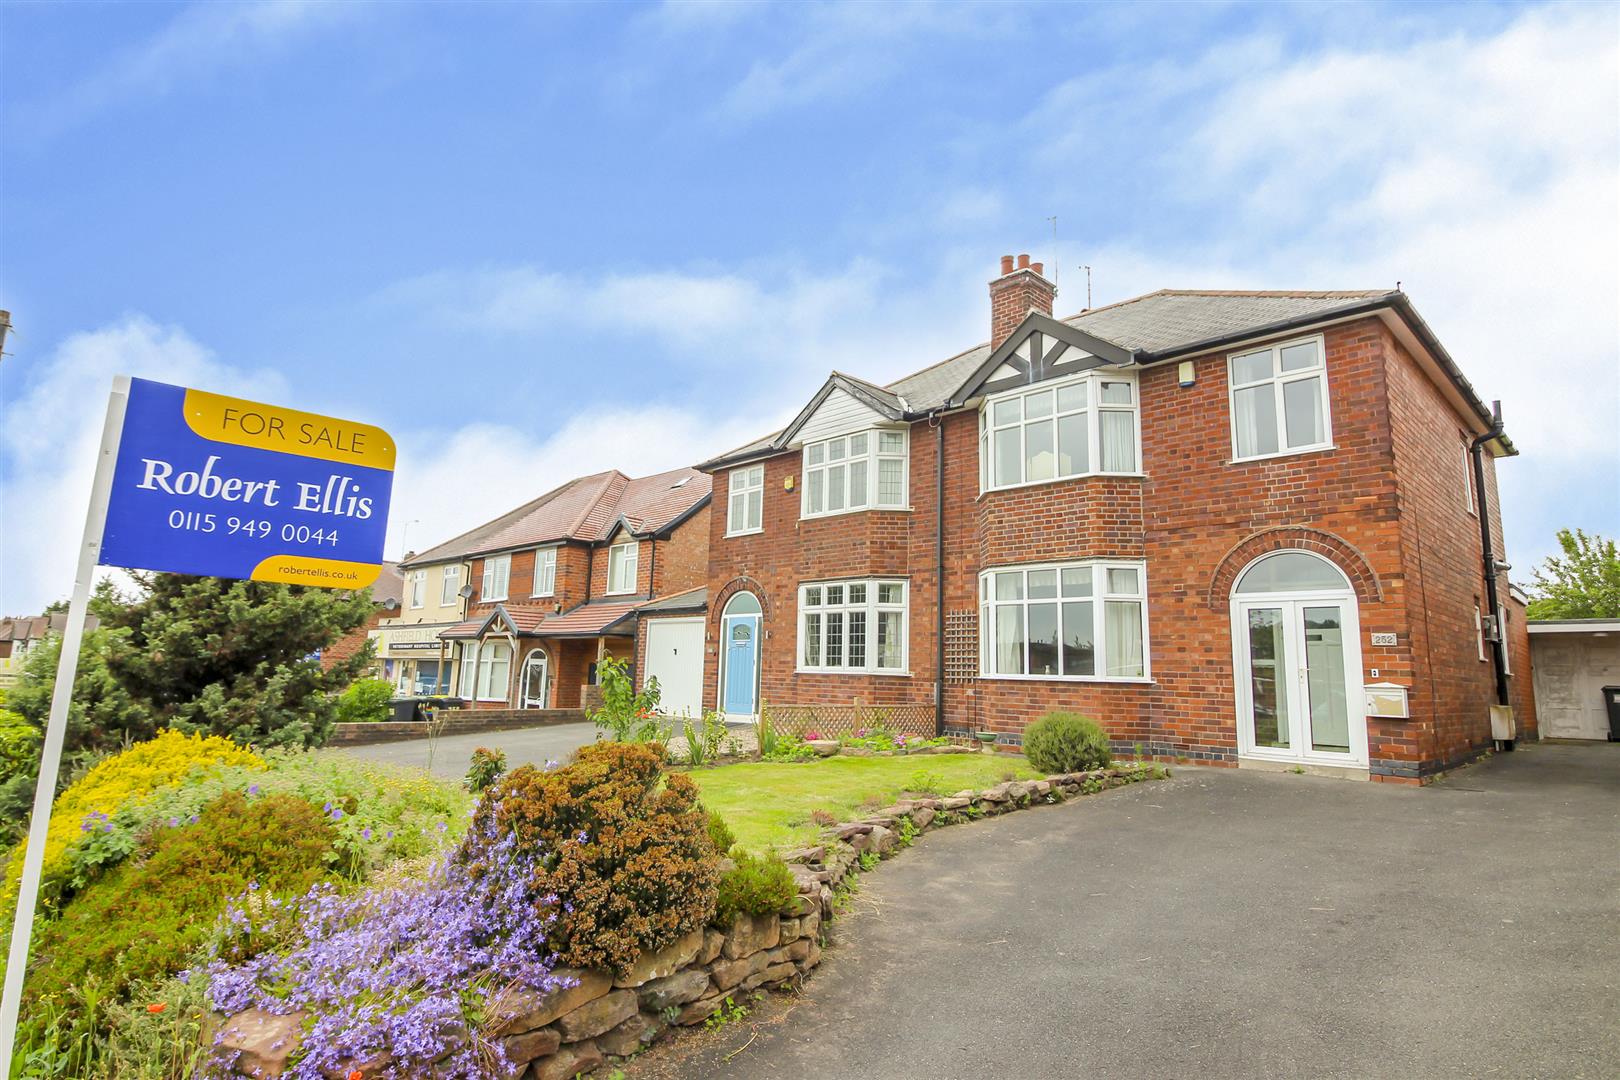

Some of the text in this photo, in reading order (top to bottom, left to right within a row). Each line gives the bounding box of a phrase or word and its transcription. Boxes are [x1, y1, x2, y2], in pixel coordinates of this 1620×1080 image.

[222, 408, 368, 455] FOR SALE
[136, 455, 374, 520] Robert Ellis
[168, 510, 339, 547] 0115 949 0044
[278, 565, 358, 581] robertellis.co.uk
